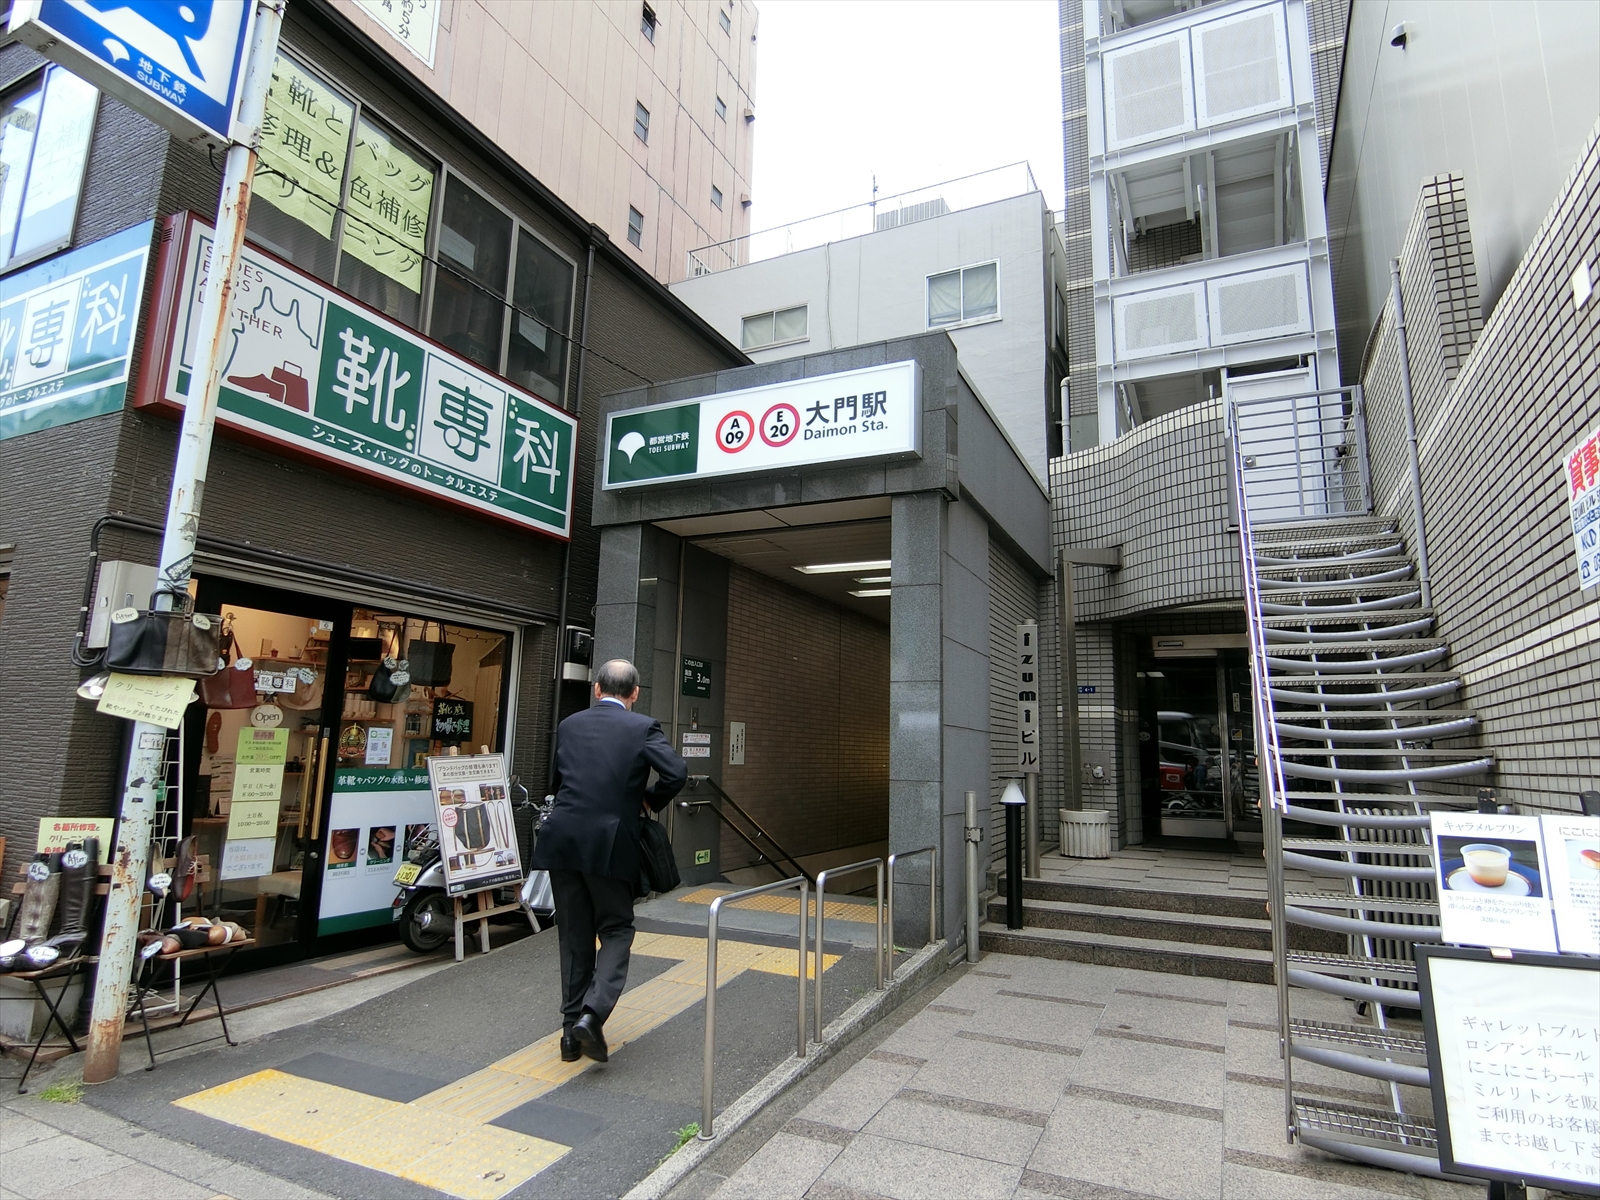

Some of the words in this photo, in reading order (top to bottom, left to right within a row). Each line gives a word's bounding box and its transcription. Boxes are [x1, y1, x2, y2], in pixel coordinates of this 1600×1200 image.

[138, 56, 188, 97] 地下鉄
[136, 70, 186, 105] SUBWAY
[350, 175, 426, 239] 色補修
[332, 327, 561, 494] 靴専科
[777, 411, 783, 423] E
[805, 390, 888, 427] 大門駅
[730, 418, 740, 430] A
[770, 424, 789, 438] 20
[804, 421, 857, 441] Daimon
[861, 419, 889, 433] Sta.
[648, 431, 690, 446] 都営地下鉄
[725, 431, 744, 445] 09
[648, 443, 661, 454] TOEI
[663, 441, 689, 452] SUBWAY
[311, 424, 498, 501] シューズ・バッグのトータルエステ
[115, 611, 135, 620] After
[255, 712, 280, 723] Open
[1443, 820, 1527, 834] キャラメルプリン
[1466, 1039, 1591, 1062] ロシアンボール
[1476, 1105, 1600, 1135] ご利用のお客様
